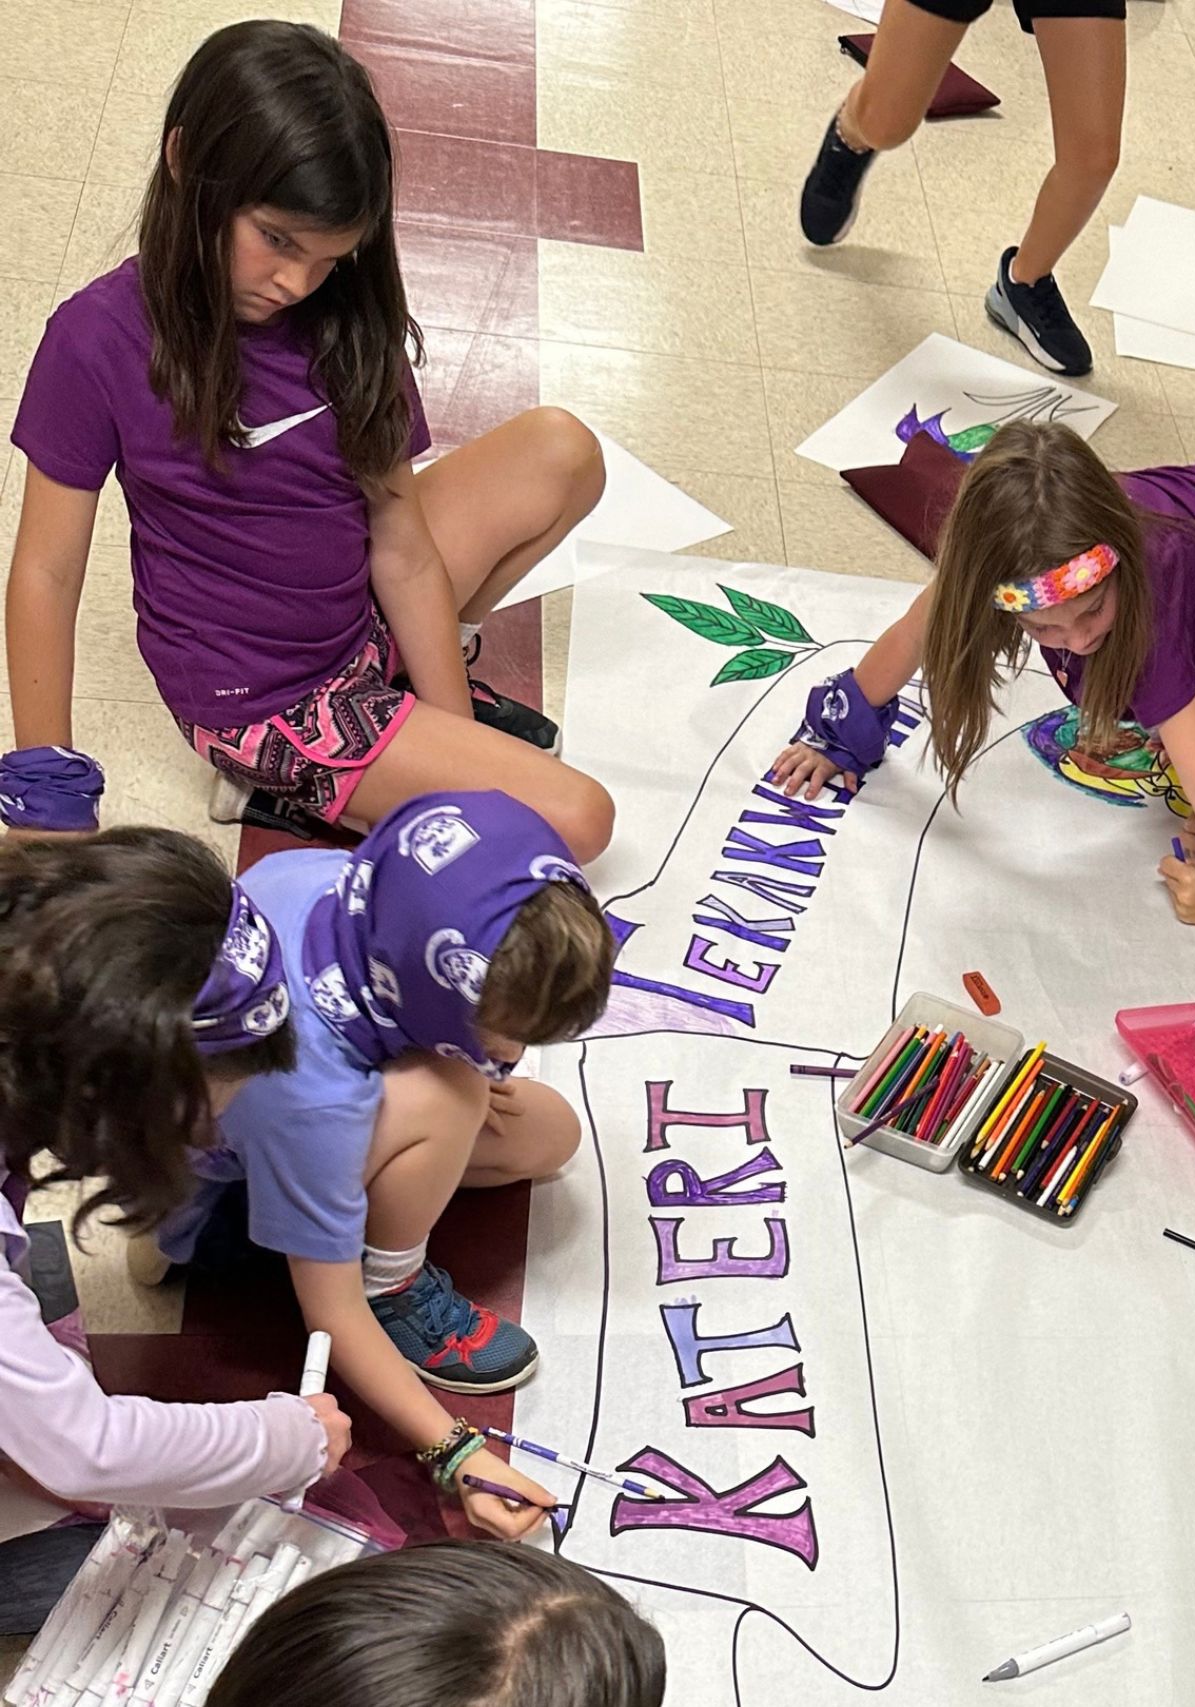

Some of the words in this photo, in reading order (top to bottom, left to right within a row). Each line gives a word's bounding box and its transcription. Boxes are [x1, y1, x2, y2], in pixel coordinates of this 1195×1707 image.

[215, 687, 250, 697] DRI-FIT
[610, 1080, 818, 1572] KATERI
[151, 1642, 171, 1675] Caliart
[193, 1647, 213, 1679] Caliart
